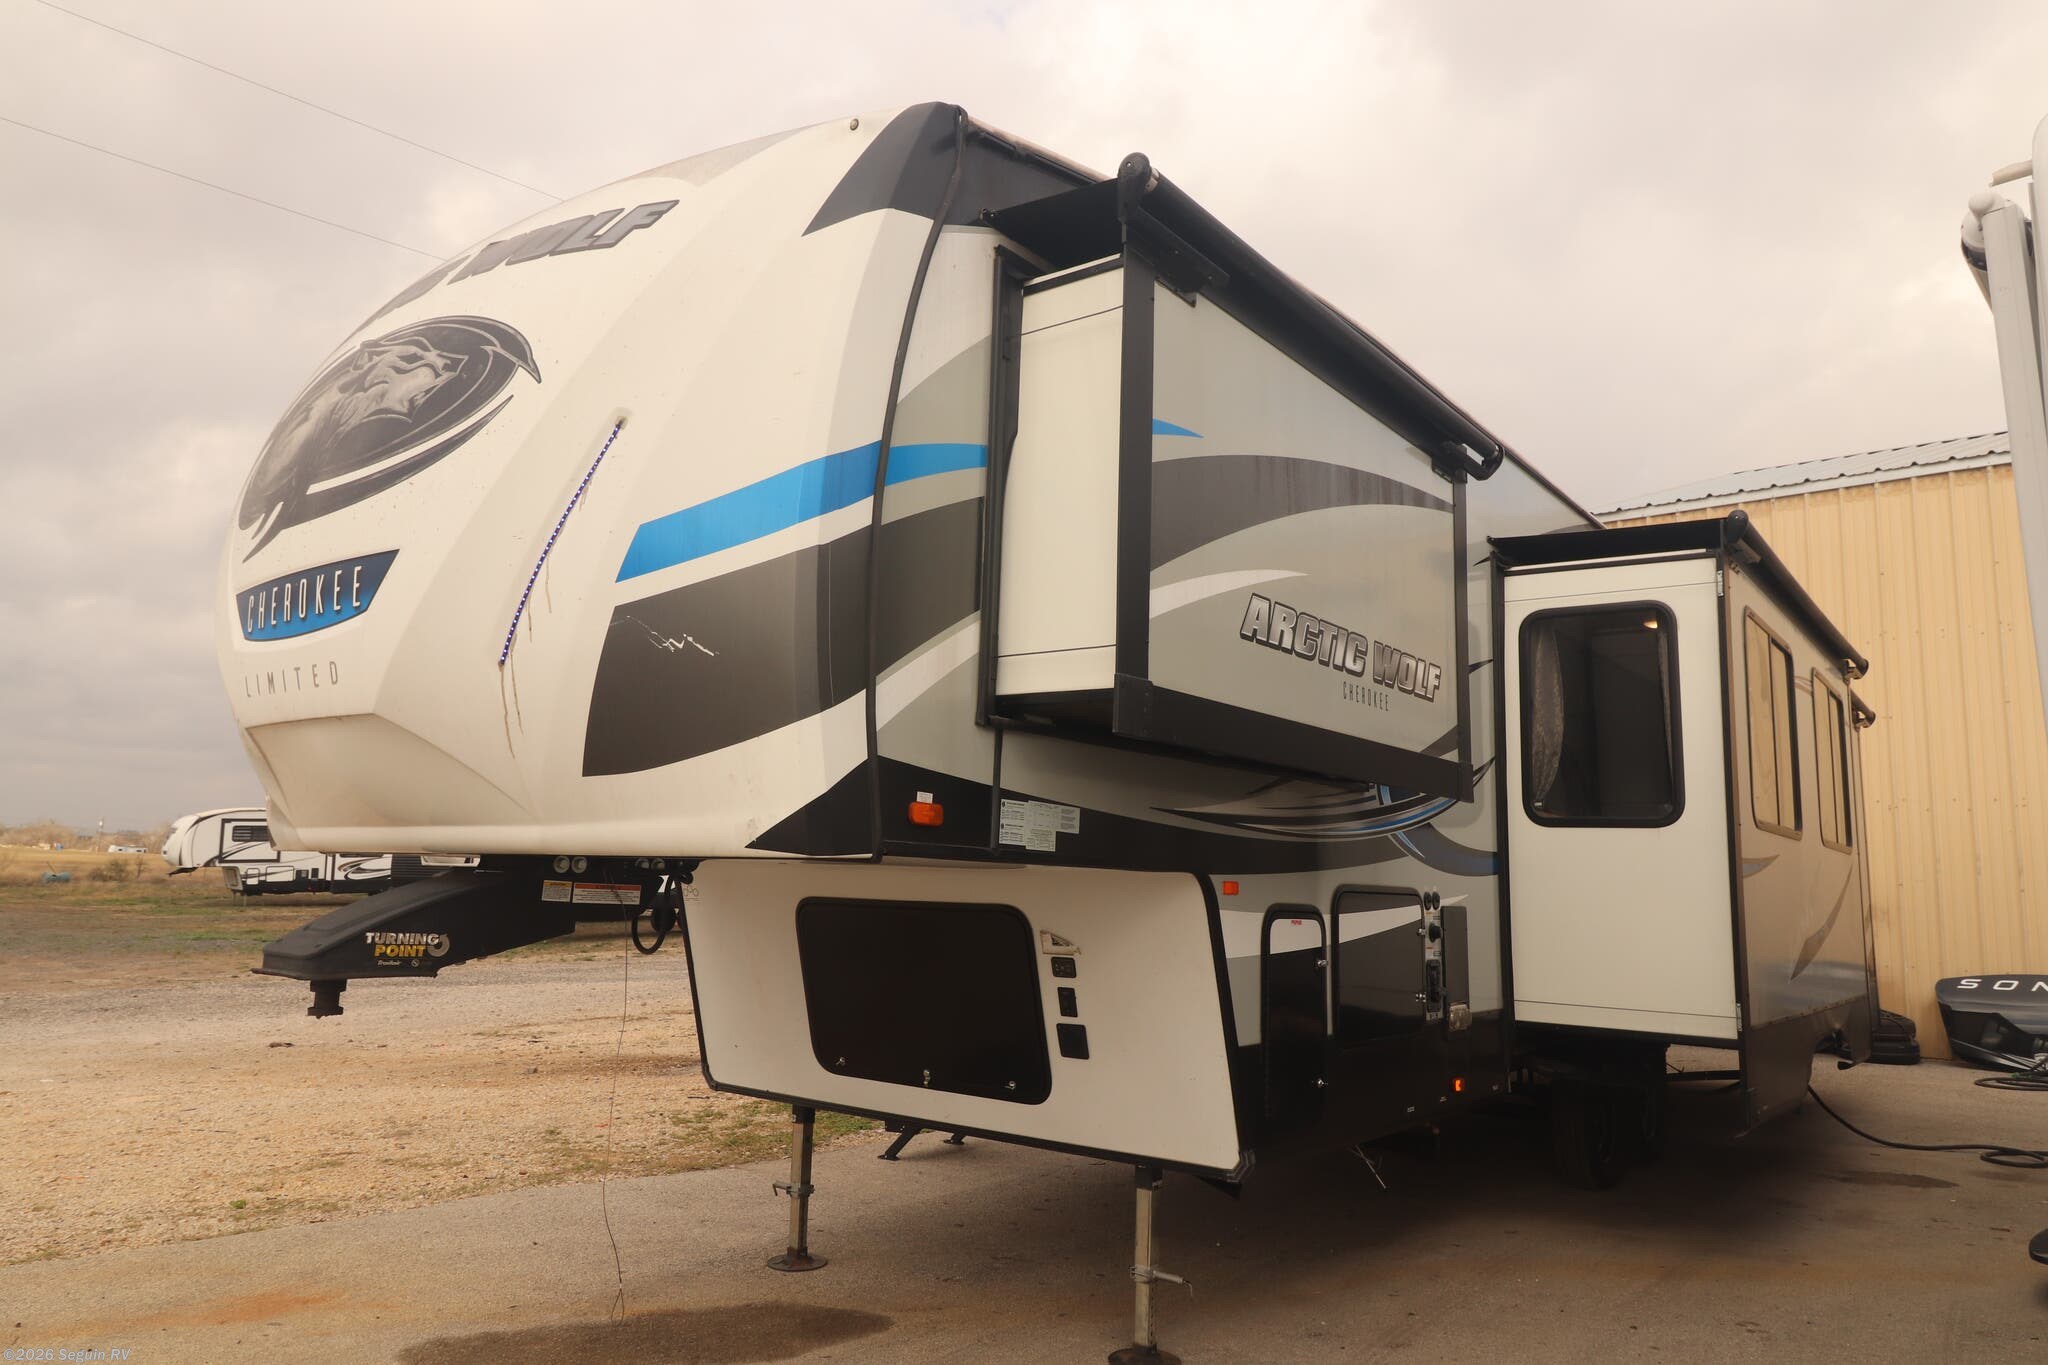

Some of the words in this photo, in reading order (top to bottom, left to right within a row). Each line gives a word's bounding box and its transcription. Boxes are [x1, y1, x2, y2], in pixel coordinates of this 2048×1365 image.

[247, 565, 363, 633] CHEROKEE
[1239, 592, 1369, 678] ARCTIC
[1373, 639, 1442, 703] WOLF
[244, 660, 339, 699] LIMITED
[1343, 680, 1389, 712] CHEROKEE
[365, 931, 440, 946] TURNING
[374, 944, 426, 958] POINT
